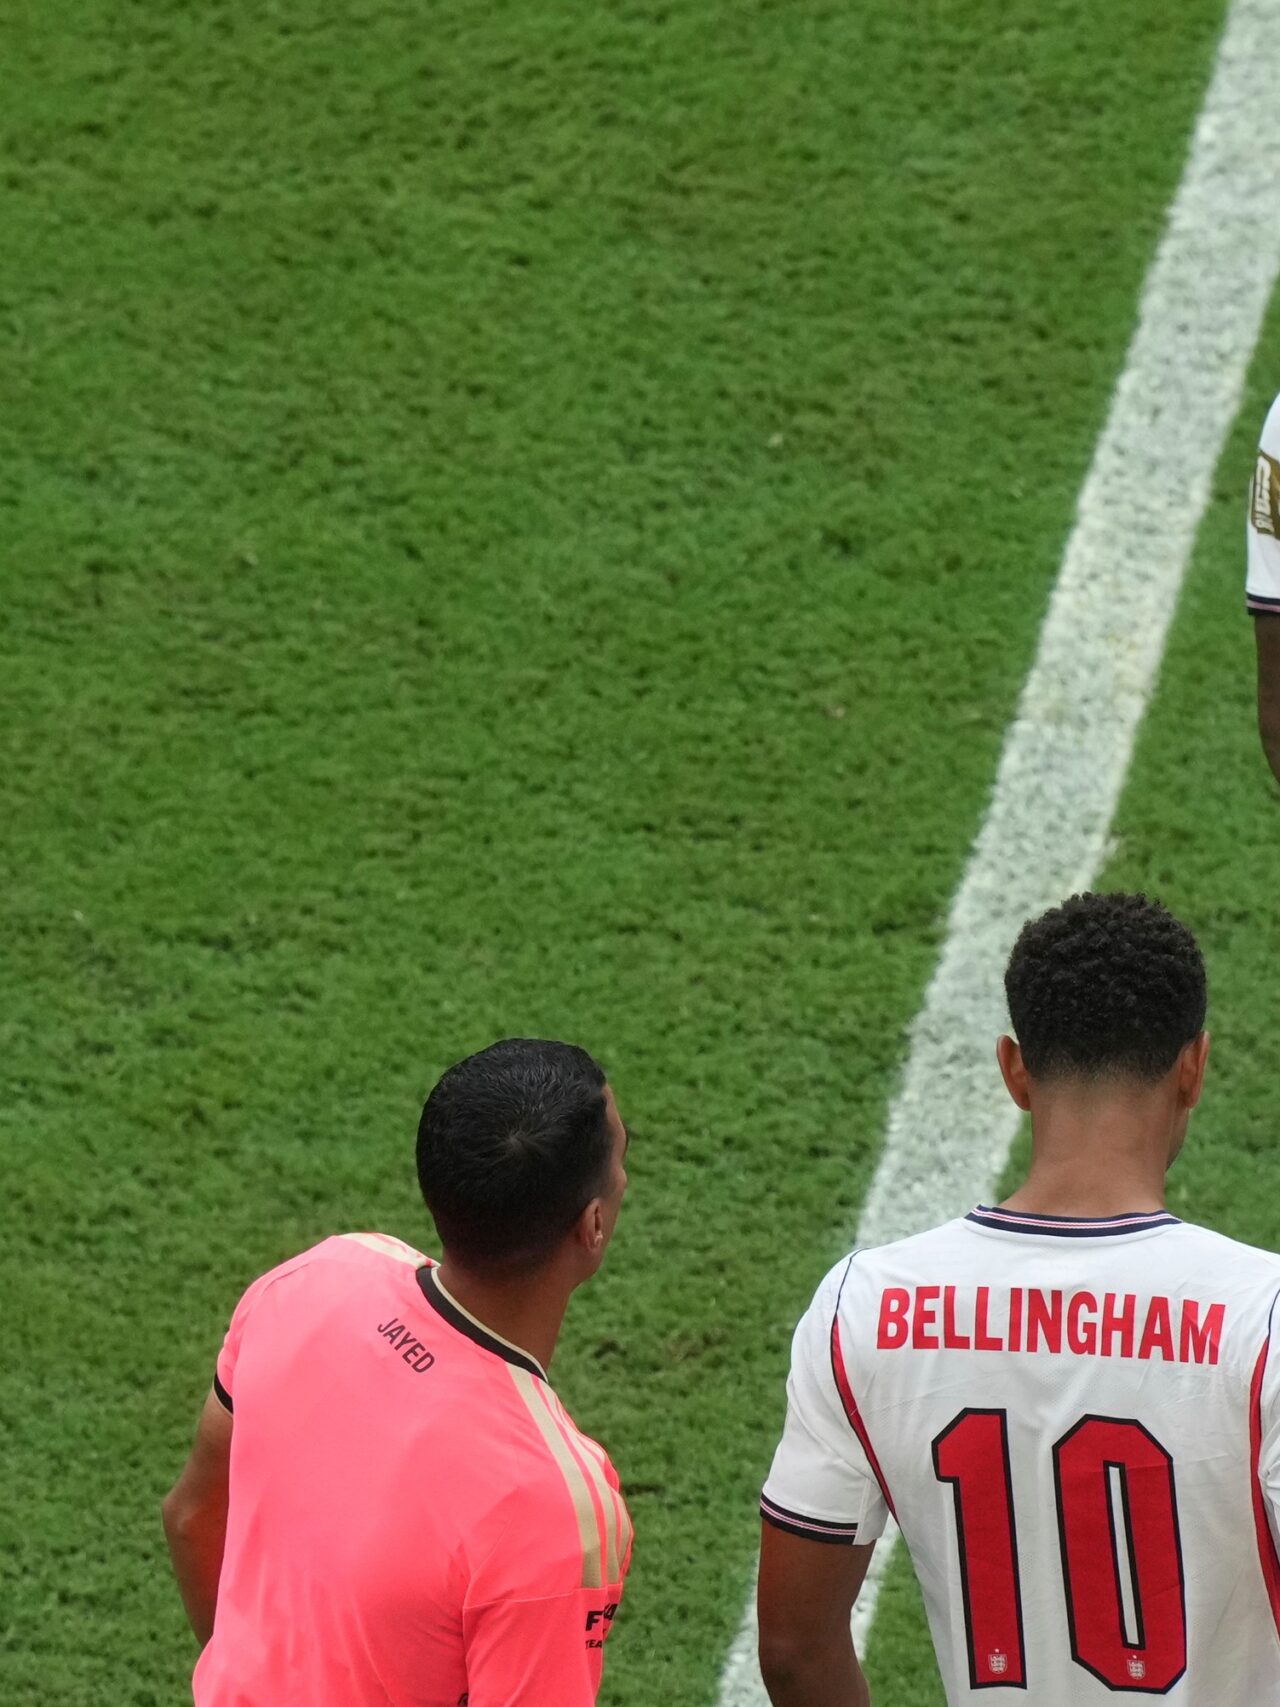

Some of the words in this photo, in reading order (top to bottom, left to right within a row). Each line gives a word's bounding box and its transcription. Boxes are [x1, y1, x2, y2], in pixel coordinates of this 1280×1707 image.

[377, 1318, 435, 1373] JAYED
[876, 1285, 1226, 1365] BELLINGHAM
[930, 1407, 1188, 1695] 10
